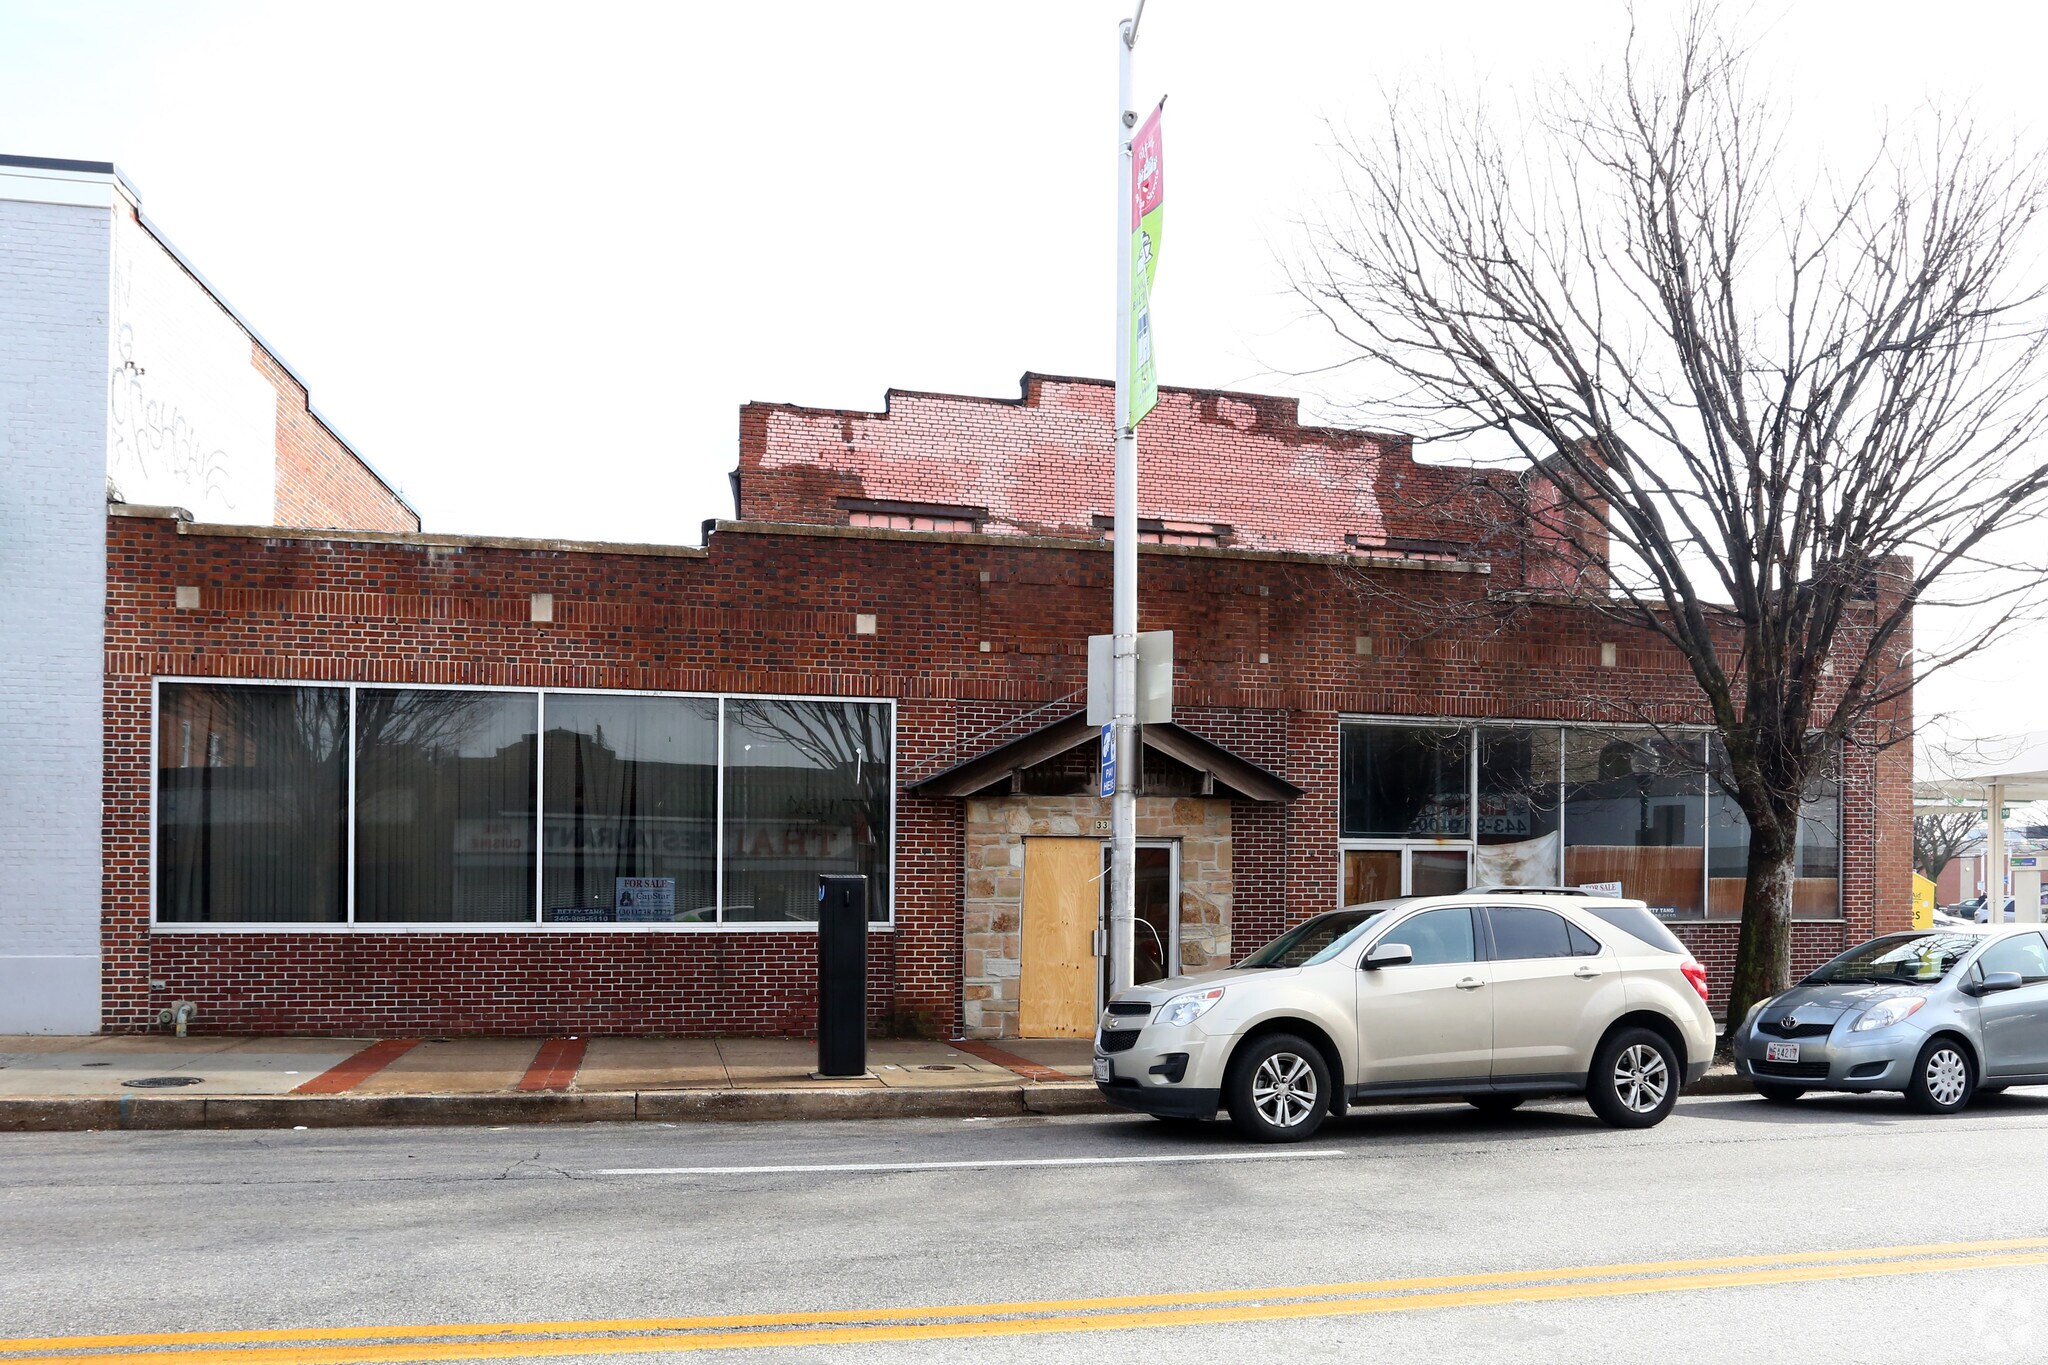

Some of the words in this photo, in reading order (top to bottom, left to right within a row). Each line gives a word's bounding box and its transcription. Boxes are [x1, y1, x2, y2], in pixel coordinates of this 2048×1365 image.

[624, 879, 642, 888] FOR
[644, 879, 667, 888] SALE
[1600, 883, 1616, 891] SALE
[636, 892, 670, 901] CapStar
